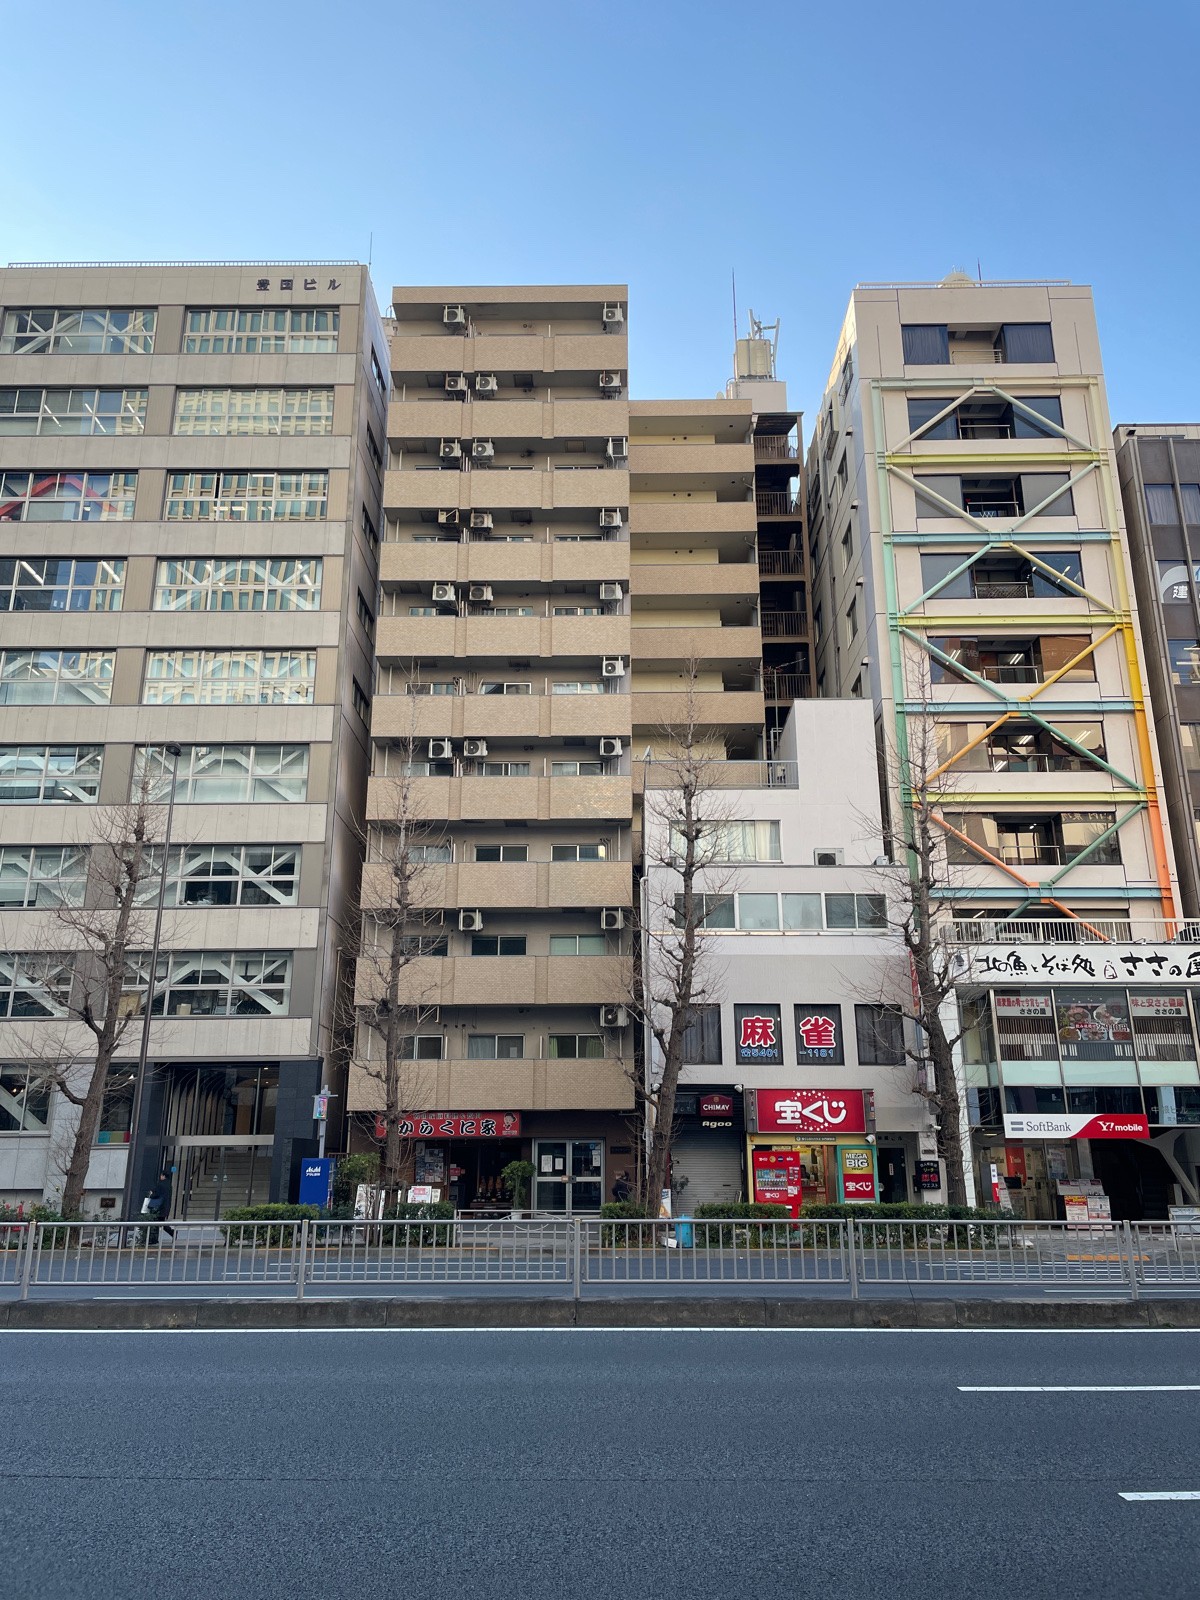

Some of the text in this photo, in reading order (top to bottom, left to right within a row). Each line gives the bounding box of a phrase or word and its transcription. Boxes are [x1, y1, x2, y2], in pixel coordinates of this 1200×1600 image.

[774, 1100, 847, 1124] 宝くじ
[398, 1119, 497, 1136] からくに家
[1026, 1121, 1072, 1132] SoftBank
[845, 1159, 868, 1168] BIG
[845, 1181, 872, 1191] 宝くじ
